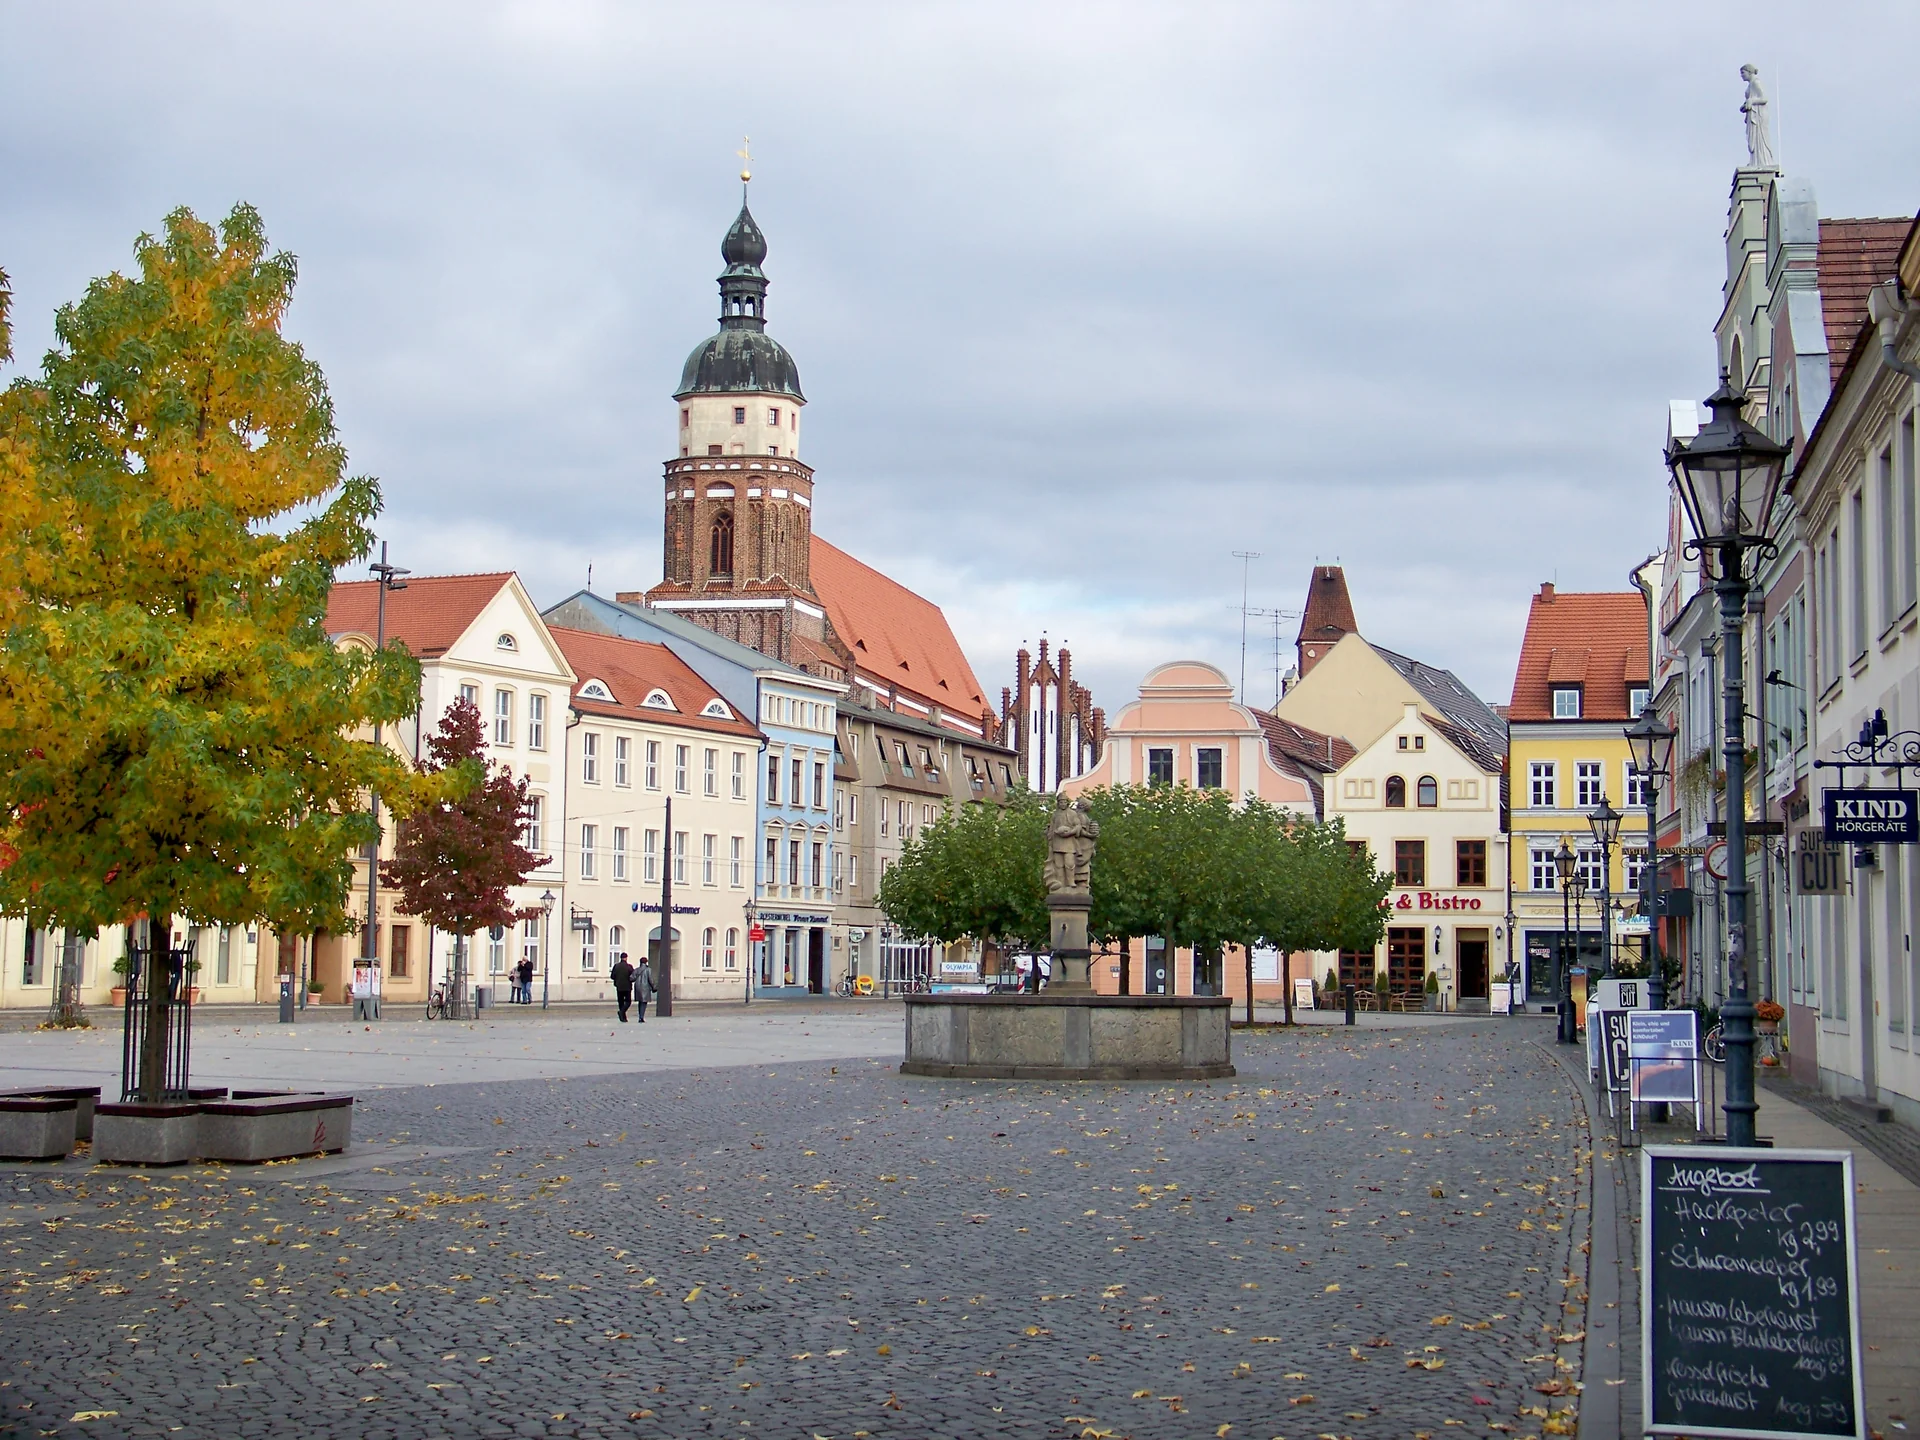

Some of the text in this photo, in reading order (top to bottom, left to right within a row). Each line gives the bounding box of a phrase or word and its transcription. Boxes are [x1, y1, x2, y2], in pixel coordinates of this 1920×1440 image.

[1835, 800, 1907, 818] KIND
[1836, 819, 1907, 832] HÖRGERÄTE
[1622, 847, 1706, 855] APOTHENMUSEUM
[1801, 852, 1840, 890] CUT
[1418, 892, 1481, 910] Bistro
[1621, 983, 1635, 991] SUPER
[1621, 991, 1636, 1006] CUT
[1667, 1162, 1762, 1197] Angebot
[1778, 1276, 1800, 1308] kg
